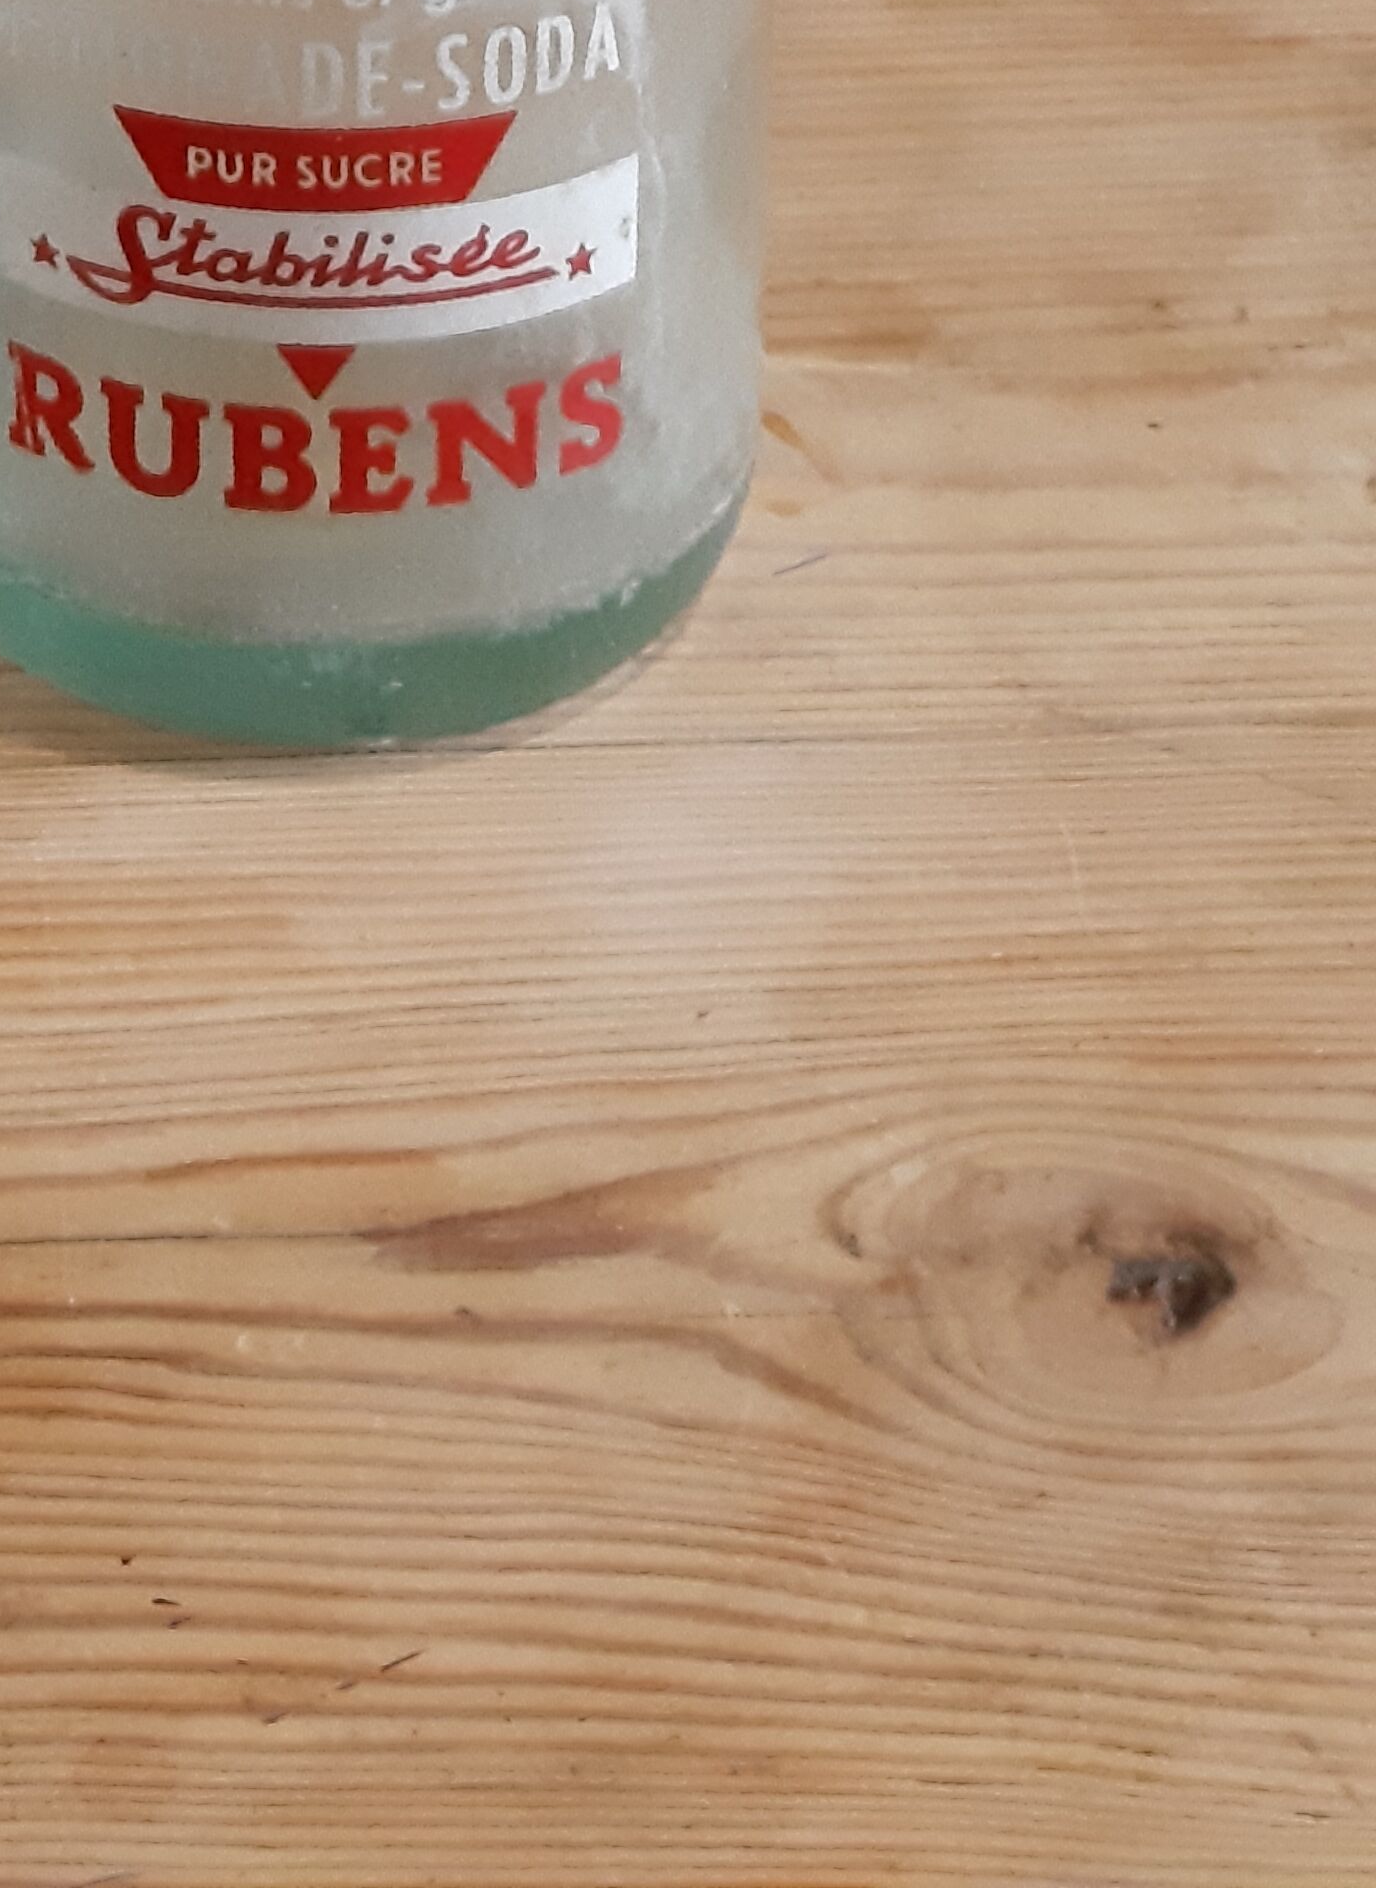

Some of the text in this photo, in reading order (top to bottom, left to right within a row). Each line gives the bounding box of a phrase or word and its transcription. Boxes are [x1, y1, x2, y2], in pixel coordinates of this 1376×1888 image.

[186, 144, 443, 188] PUR SUCRE
[66, 203, 557, 309] Stabilisée
[8, 339, 624, 515] RUBENS
